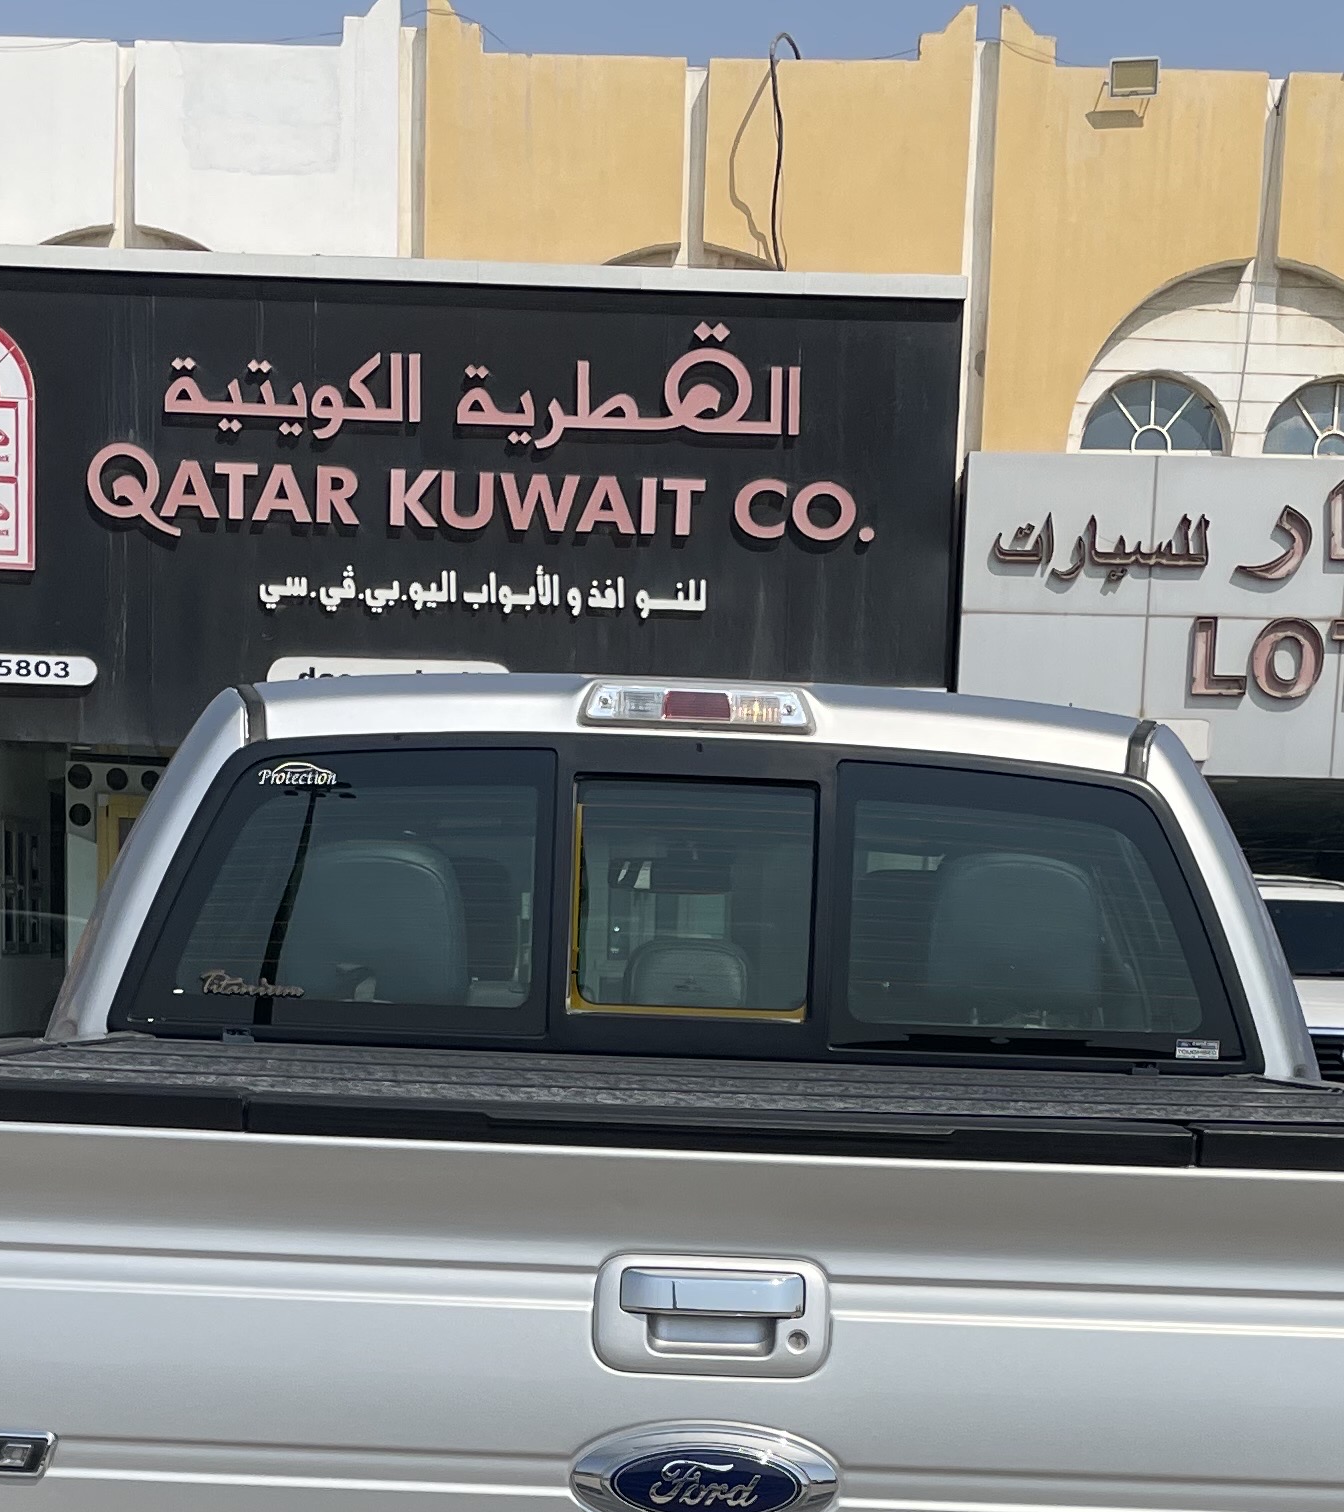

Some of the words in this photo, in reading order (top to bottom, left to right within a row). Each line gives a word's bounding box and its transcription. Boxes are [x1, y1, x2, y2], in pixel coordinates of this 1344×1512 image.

[164, 352, 421, 440] الكويتية
[456, 321, 801, 448] القطرية
[87, 442, 359, 536] QATAR
[389, 468, 707, 535] KUWAIT
[733, 479, 875, 542] CO.
[994, 512, 1211, 583] للسيارات
[463, 565, 560, 613] الأبواب
[258, 768, 337, 785] Protection
[649, 1460, 761, 1508] Ford
